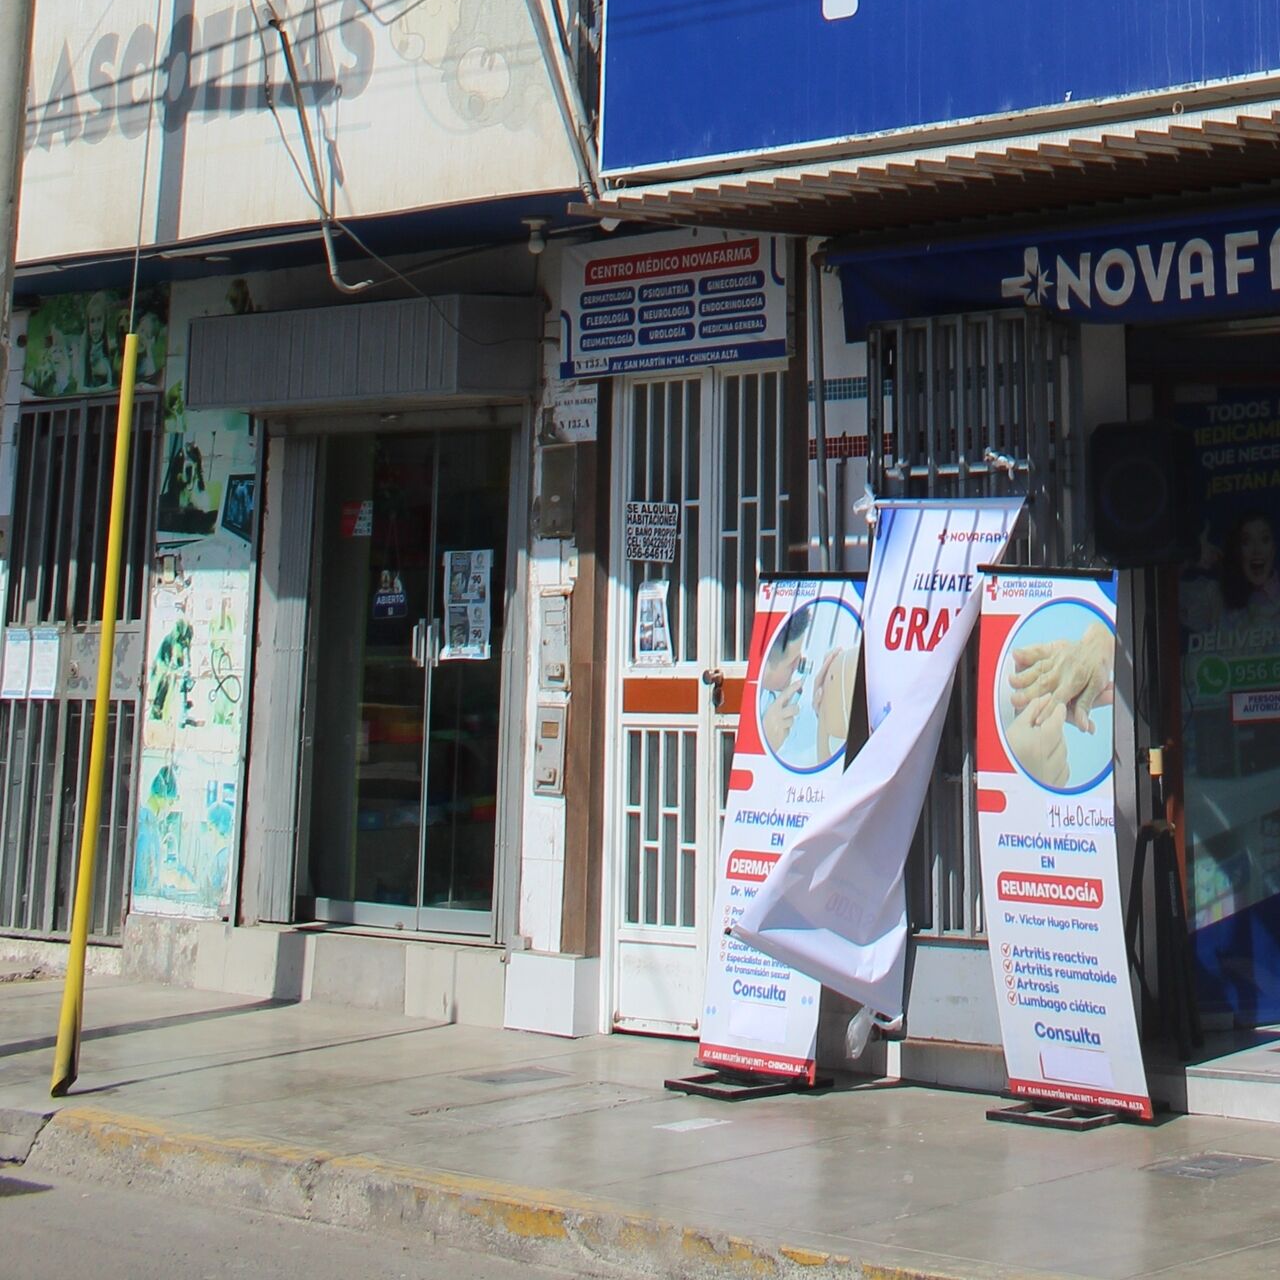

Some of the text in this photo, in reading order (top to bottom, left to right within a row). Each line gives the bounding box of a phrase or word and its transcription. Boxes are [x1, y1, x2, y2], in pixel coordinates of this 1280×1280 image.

[590, 247, 752, 280] CENTRO MÉDICO NOVAFARMA
[642, 283, 690, 298] PSIQUIATRÍA
[707, 274, 757, 290] GINECOLOGÍA
[583, 290, 633, 305] DERMATOLOGÍA
[701, 297, 763, 313] ENDOCRINOLOGÍA
[586, 312, 630, 327] FLEBOLOGÍA
[643, 305, 690, 320] NEUROLOGÍA
[649, 326, 686, 340] UROLOGÍA
[702, 318, 764, 334] MEDICINA GENERAL
[582, 332, 634, 348] REUMATOLOGÍA
[612, 361, 624, 371] AV.
[624, 359, 638, 369] SAN
[690, 351, 720, 363] CHINCHA
[721, 349, 739, 360] ALTA
[1207, 400, 1270, 422] TODOS
[1201, 448, 1235, 470] QUE
[1207, 467, 1267, 499] ¡ESTÁN
[627, 503, 677, 515] SE ALQUILA
[627, 514, 676, 526] HABITACIONES
[627, 547, 674, 560] 056-646112
[1002, 579, 1053, 588] CENTRO MÉDICO
[1002, 589, 1053, 598] NOVAFARMA
[884, 605, 961, 652] GRA
[1235, 663, 1268, 682] 956
[786, 785, 796, 803] 14
[734, 808, 785, 827] ATENCIÓN
[1049, 804, 1076, 828] 14 de
[771, 833, 785, 847] EN
[998, 832, 1097, 853] ATENCIÓN MÉDICA
[1041, 856, 1055, 869] EN
[730, 885, 742, 897] Dr.
[1000, 879, 1099, 903] REUMATOLOGÍA
[1004, 912, 1018, 924] Dr.
[1047, 915, 1070, 930] Hugo
[1071, 919, 1099, 932] Flores
[727, 953, 762, 965] Especialista
[1012, 945, 1098, 966] Artritis reactiva
[734, 965, 770, 977] transmisión
[771, 972, 790, 980] sexual
[1014, 961, 1118, 985] Artritis reumatoide
[732, 979, 787, 1002] Consulta
[1016, 977, 1060, 994] Artrosis
[1018, 993, 1106, 1016] Lumbago ciática
[1034, 1021, 1102, 1046] Consulta
[712, 1051, 722, 1059] SAN
[767, 1060, 794, 1071] CHINCHA
[1028, 1086, 1040, 1096] SAN
[1098, 1096, 1128, 1108] CHINCHA
[1129, 1101, 1145, 1111] ALTA
